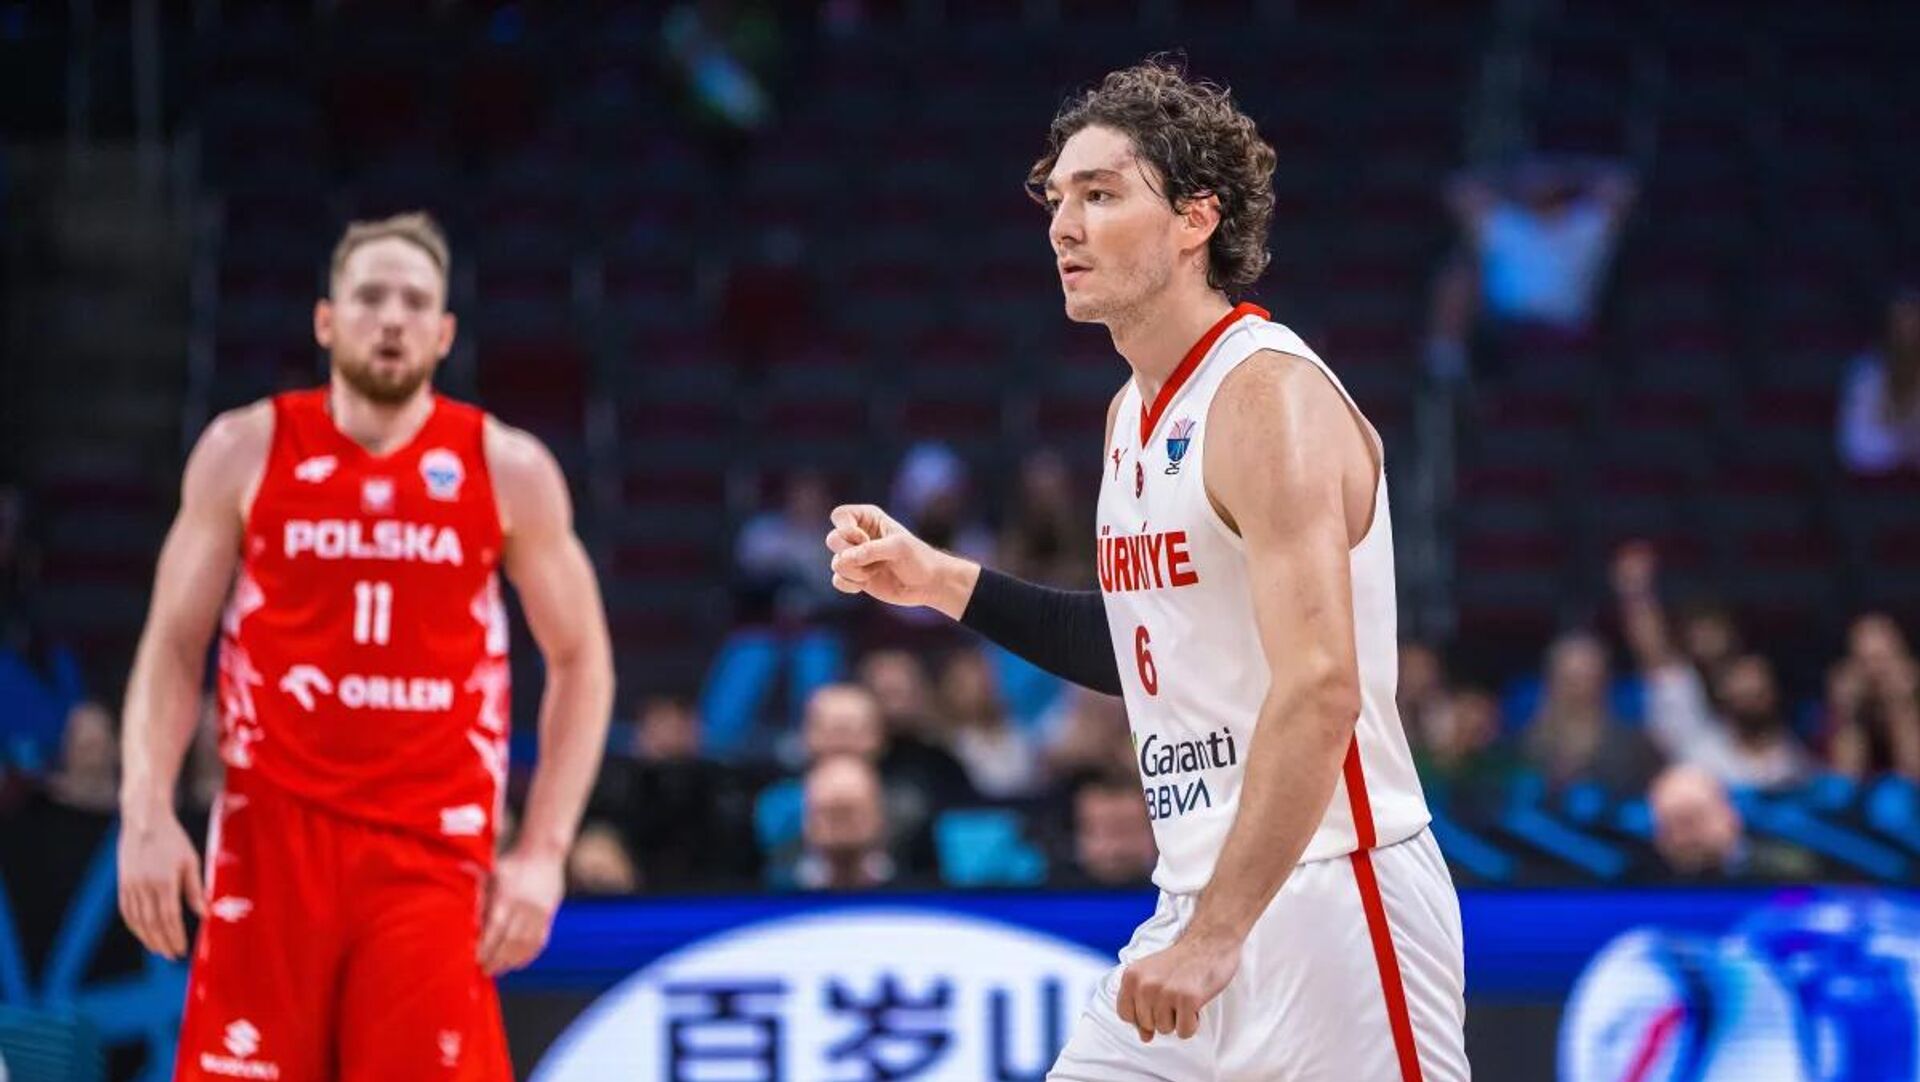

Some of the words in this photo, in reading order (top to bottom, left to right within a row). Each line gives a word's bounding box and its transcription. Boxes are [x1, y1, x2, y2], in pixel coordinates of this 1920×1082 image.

[285, 520, 462, 564] POLSKA
[1098, 521, 1198, 592] ÜRKİYE
[354, 581, 392, 644] 11
[1135, 625, 1158, 696] 6
[339, 675, 453, 711] ORLEN
[1141, 727, 1237, 777] Garanti
